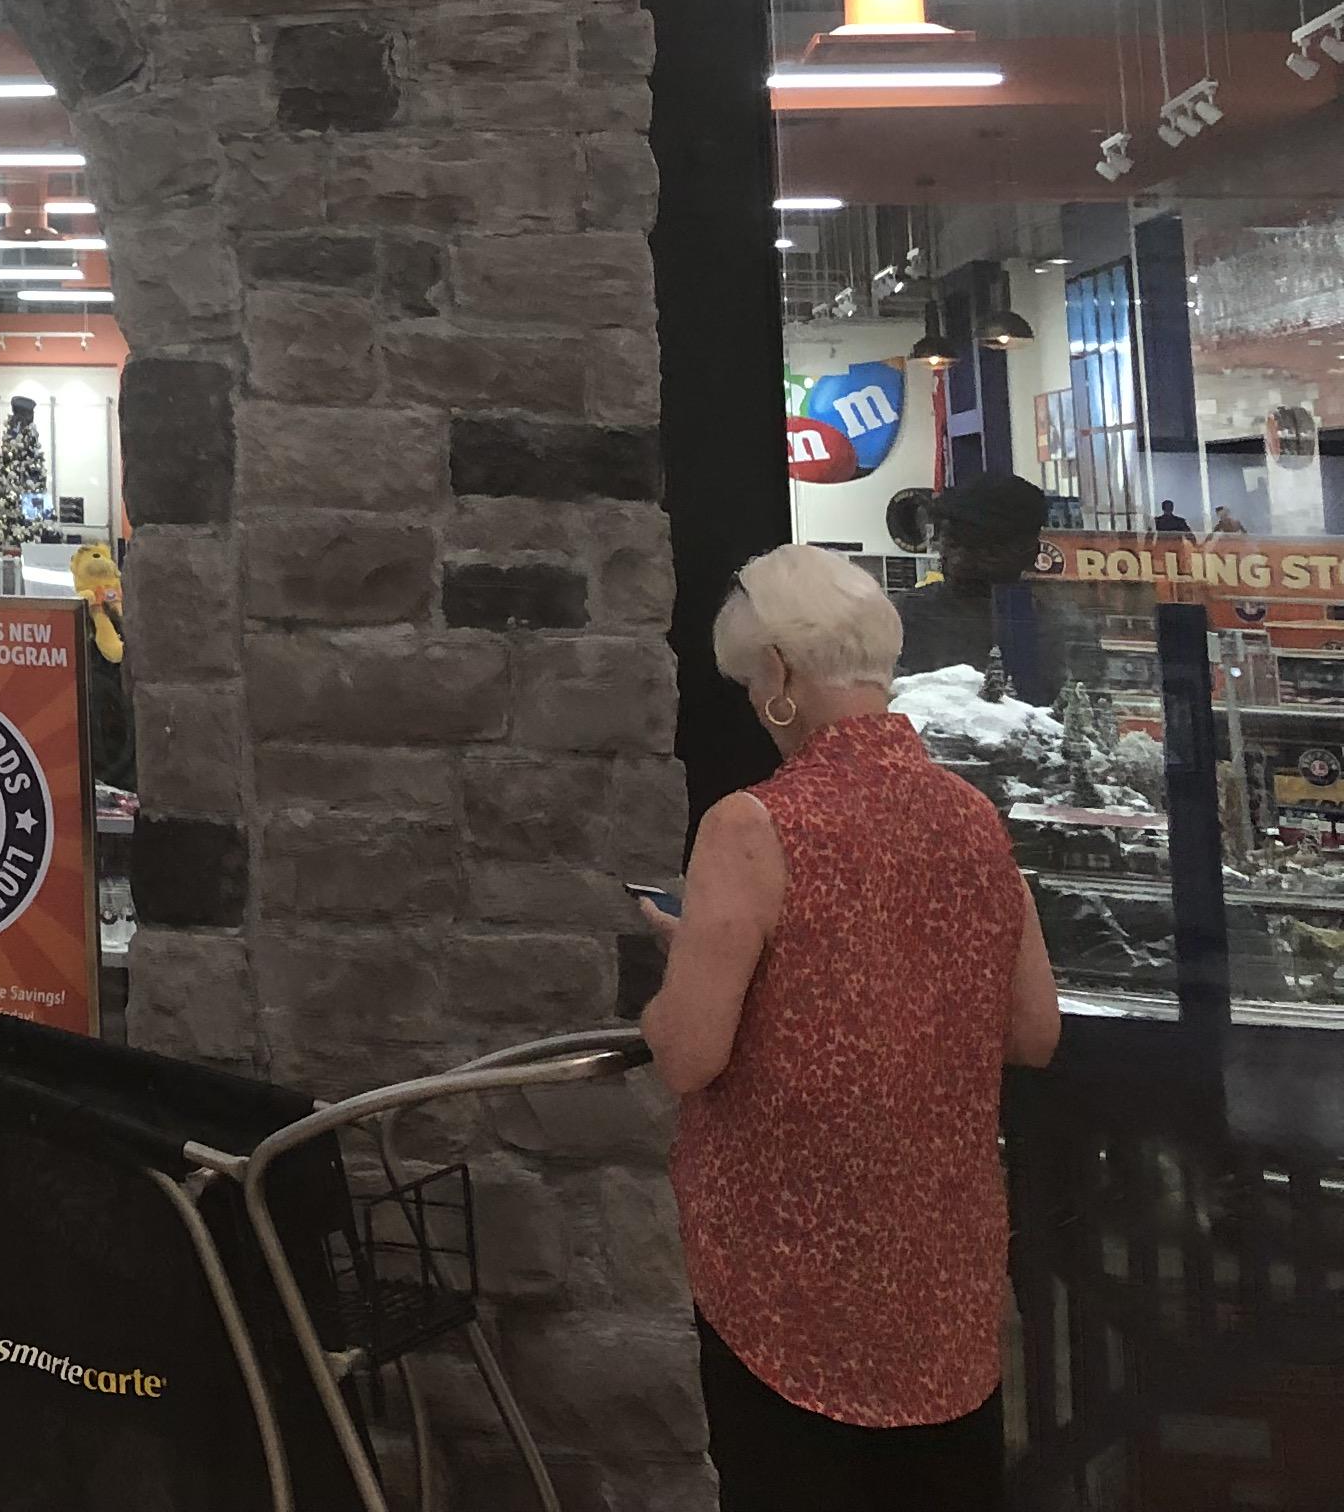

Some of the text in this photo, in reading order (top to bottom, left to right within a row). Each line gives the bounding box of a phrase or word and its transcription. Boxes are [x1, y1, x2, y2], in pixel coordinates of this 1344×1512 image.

[1076, 548, 1272, 587] ROLLING
[1281, 554, 1344, 589] ST
[9, 623, 52, 644] NEW
[10, 985, 66, 1008] Savings!
